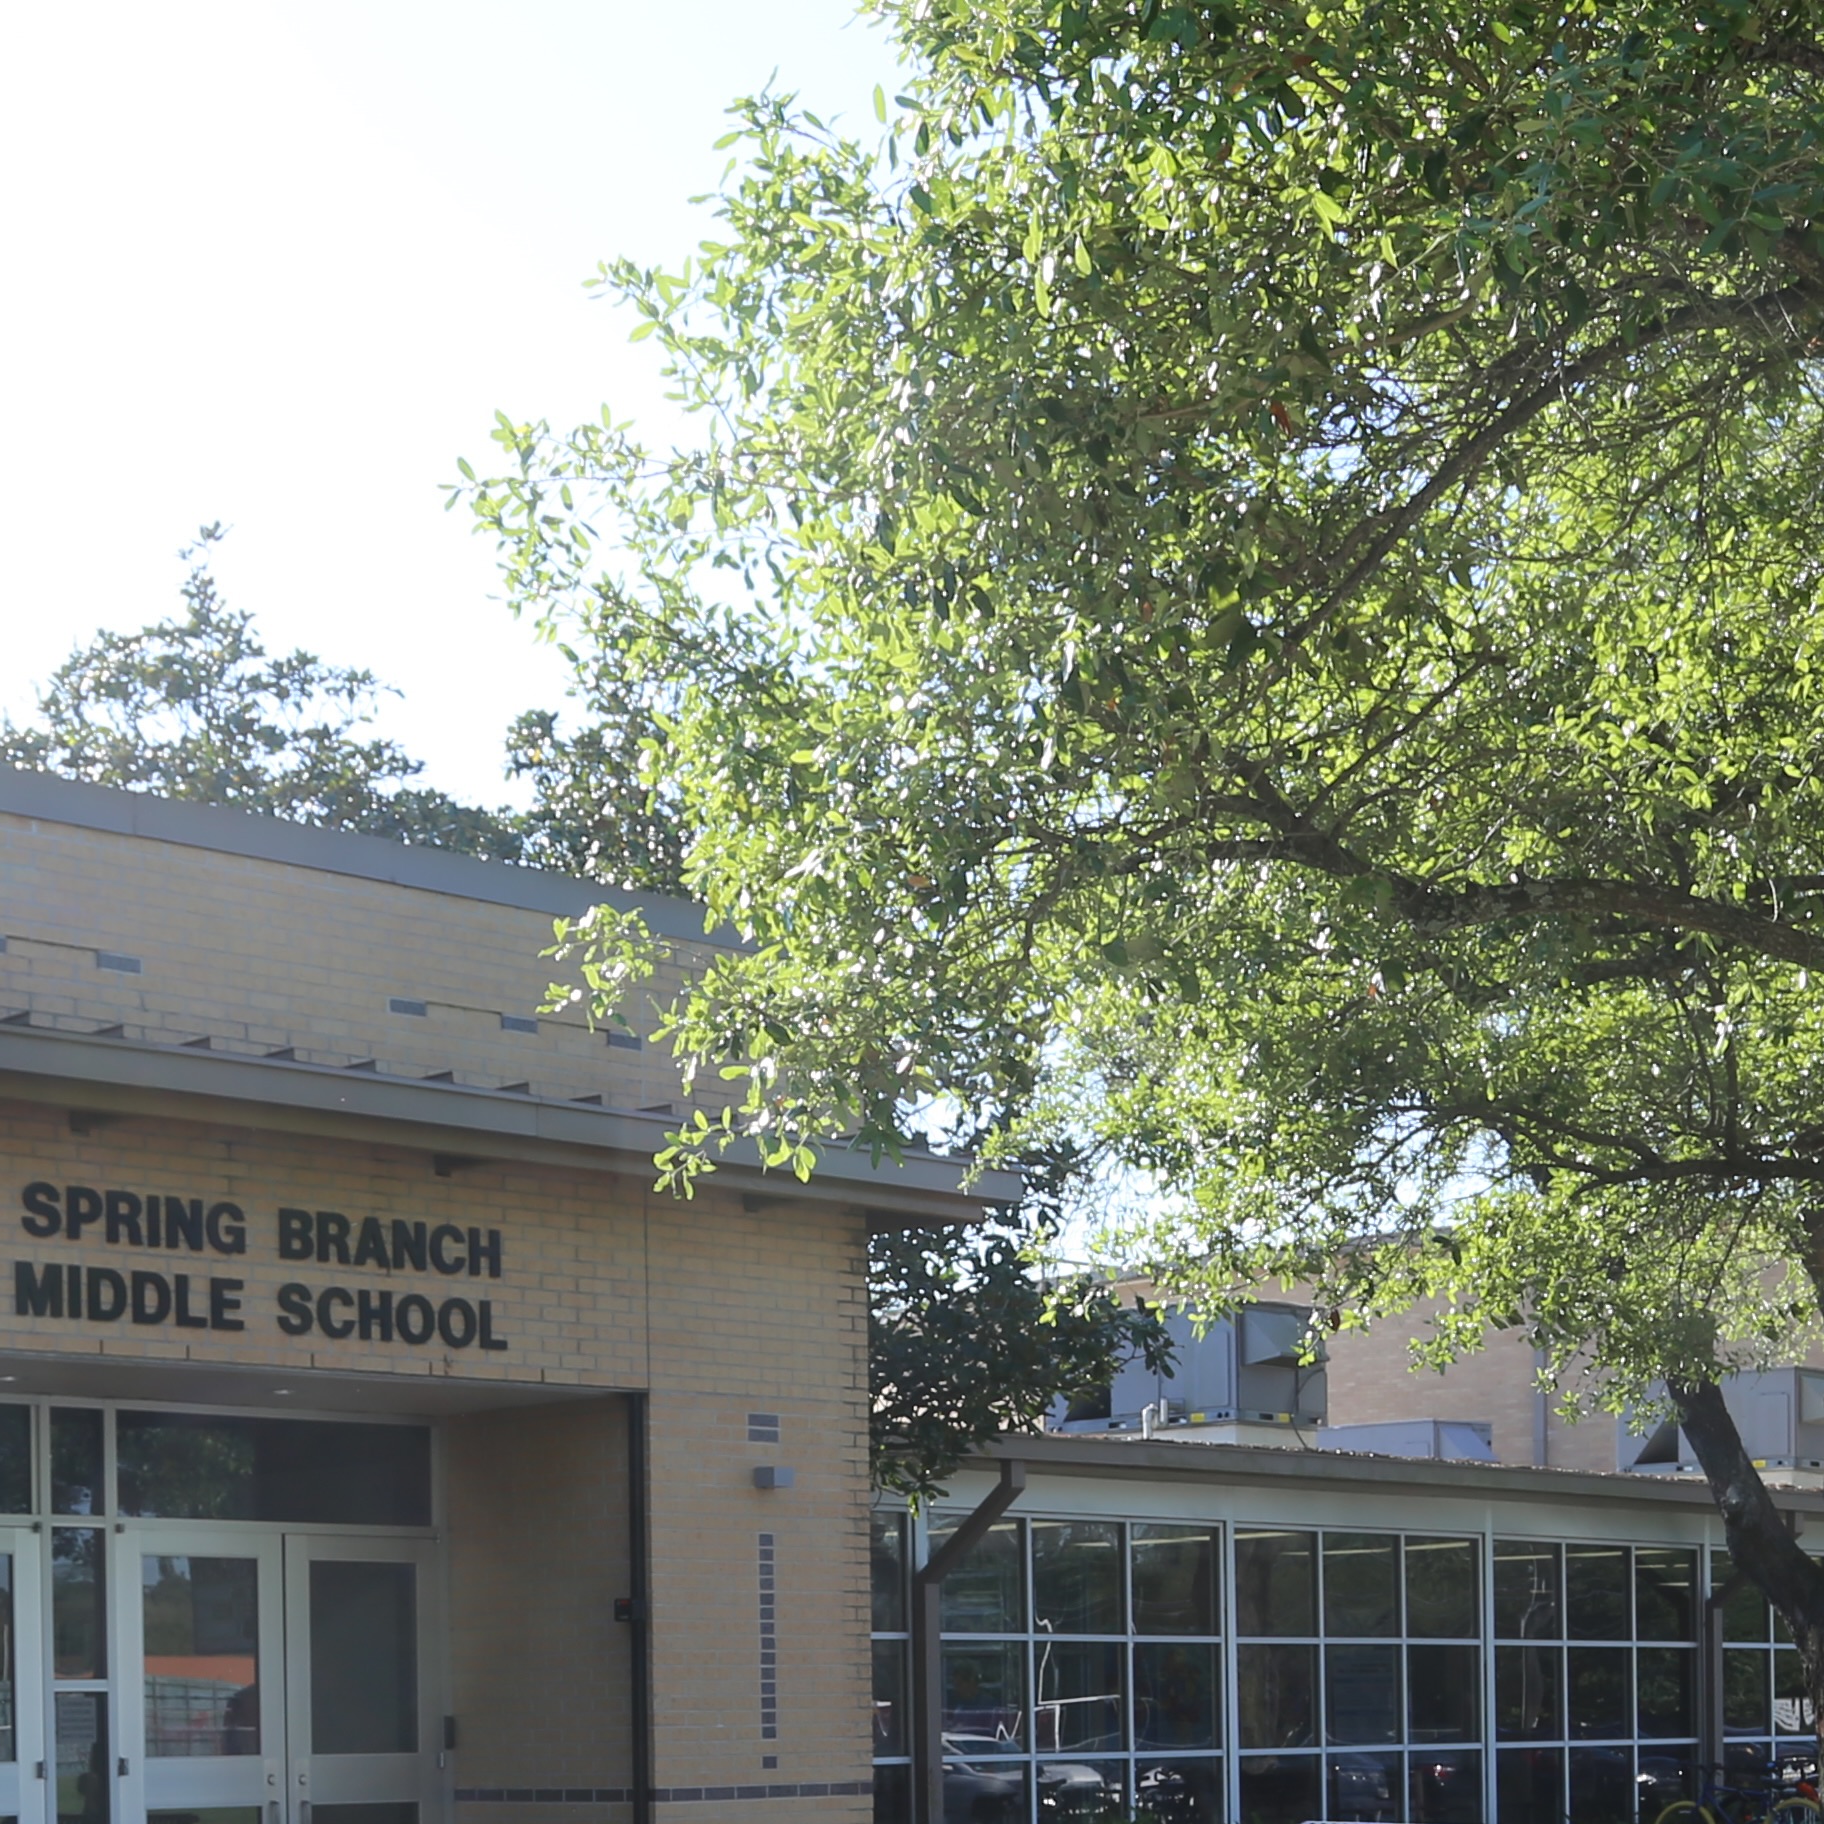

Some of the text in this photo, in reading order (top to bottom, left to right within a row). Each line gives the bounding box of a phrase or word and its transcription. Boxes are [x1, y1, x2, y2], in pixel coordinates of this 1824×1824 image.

[20, 1181, 501, 1278] SPRING BRANCH
[14, 1260, 509, 1352] MIDDLE SCHOOL
